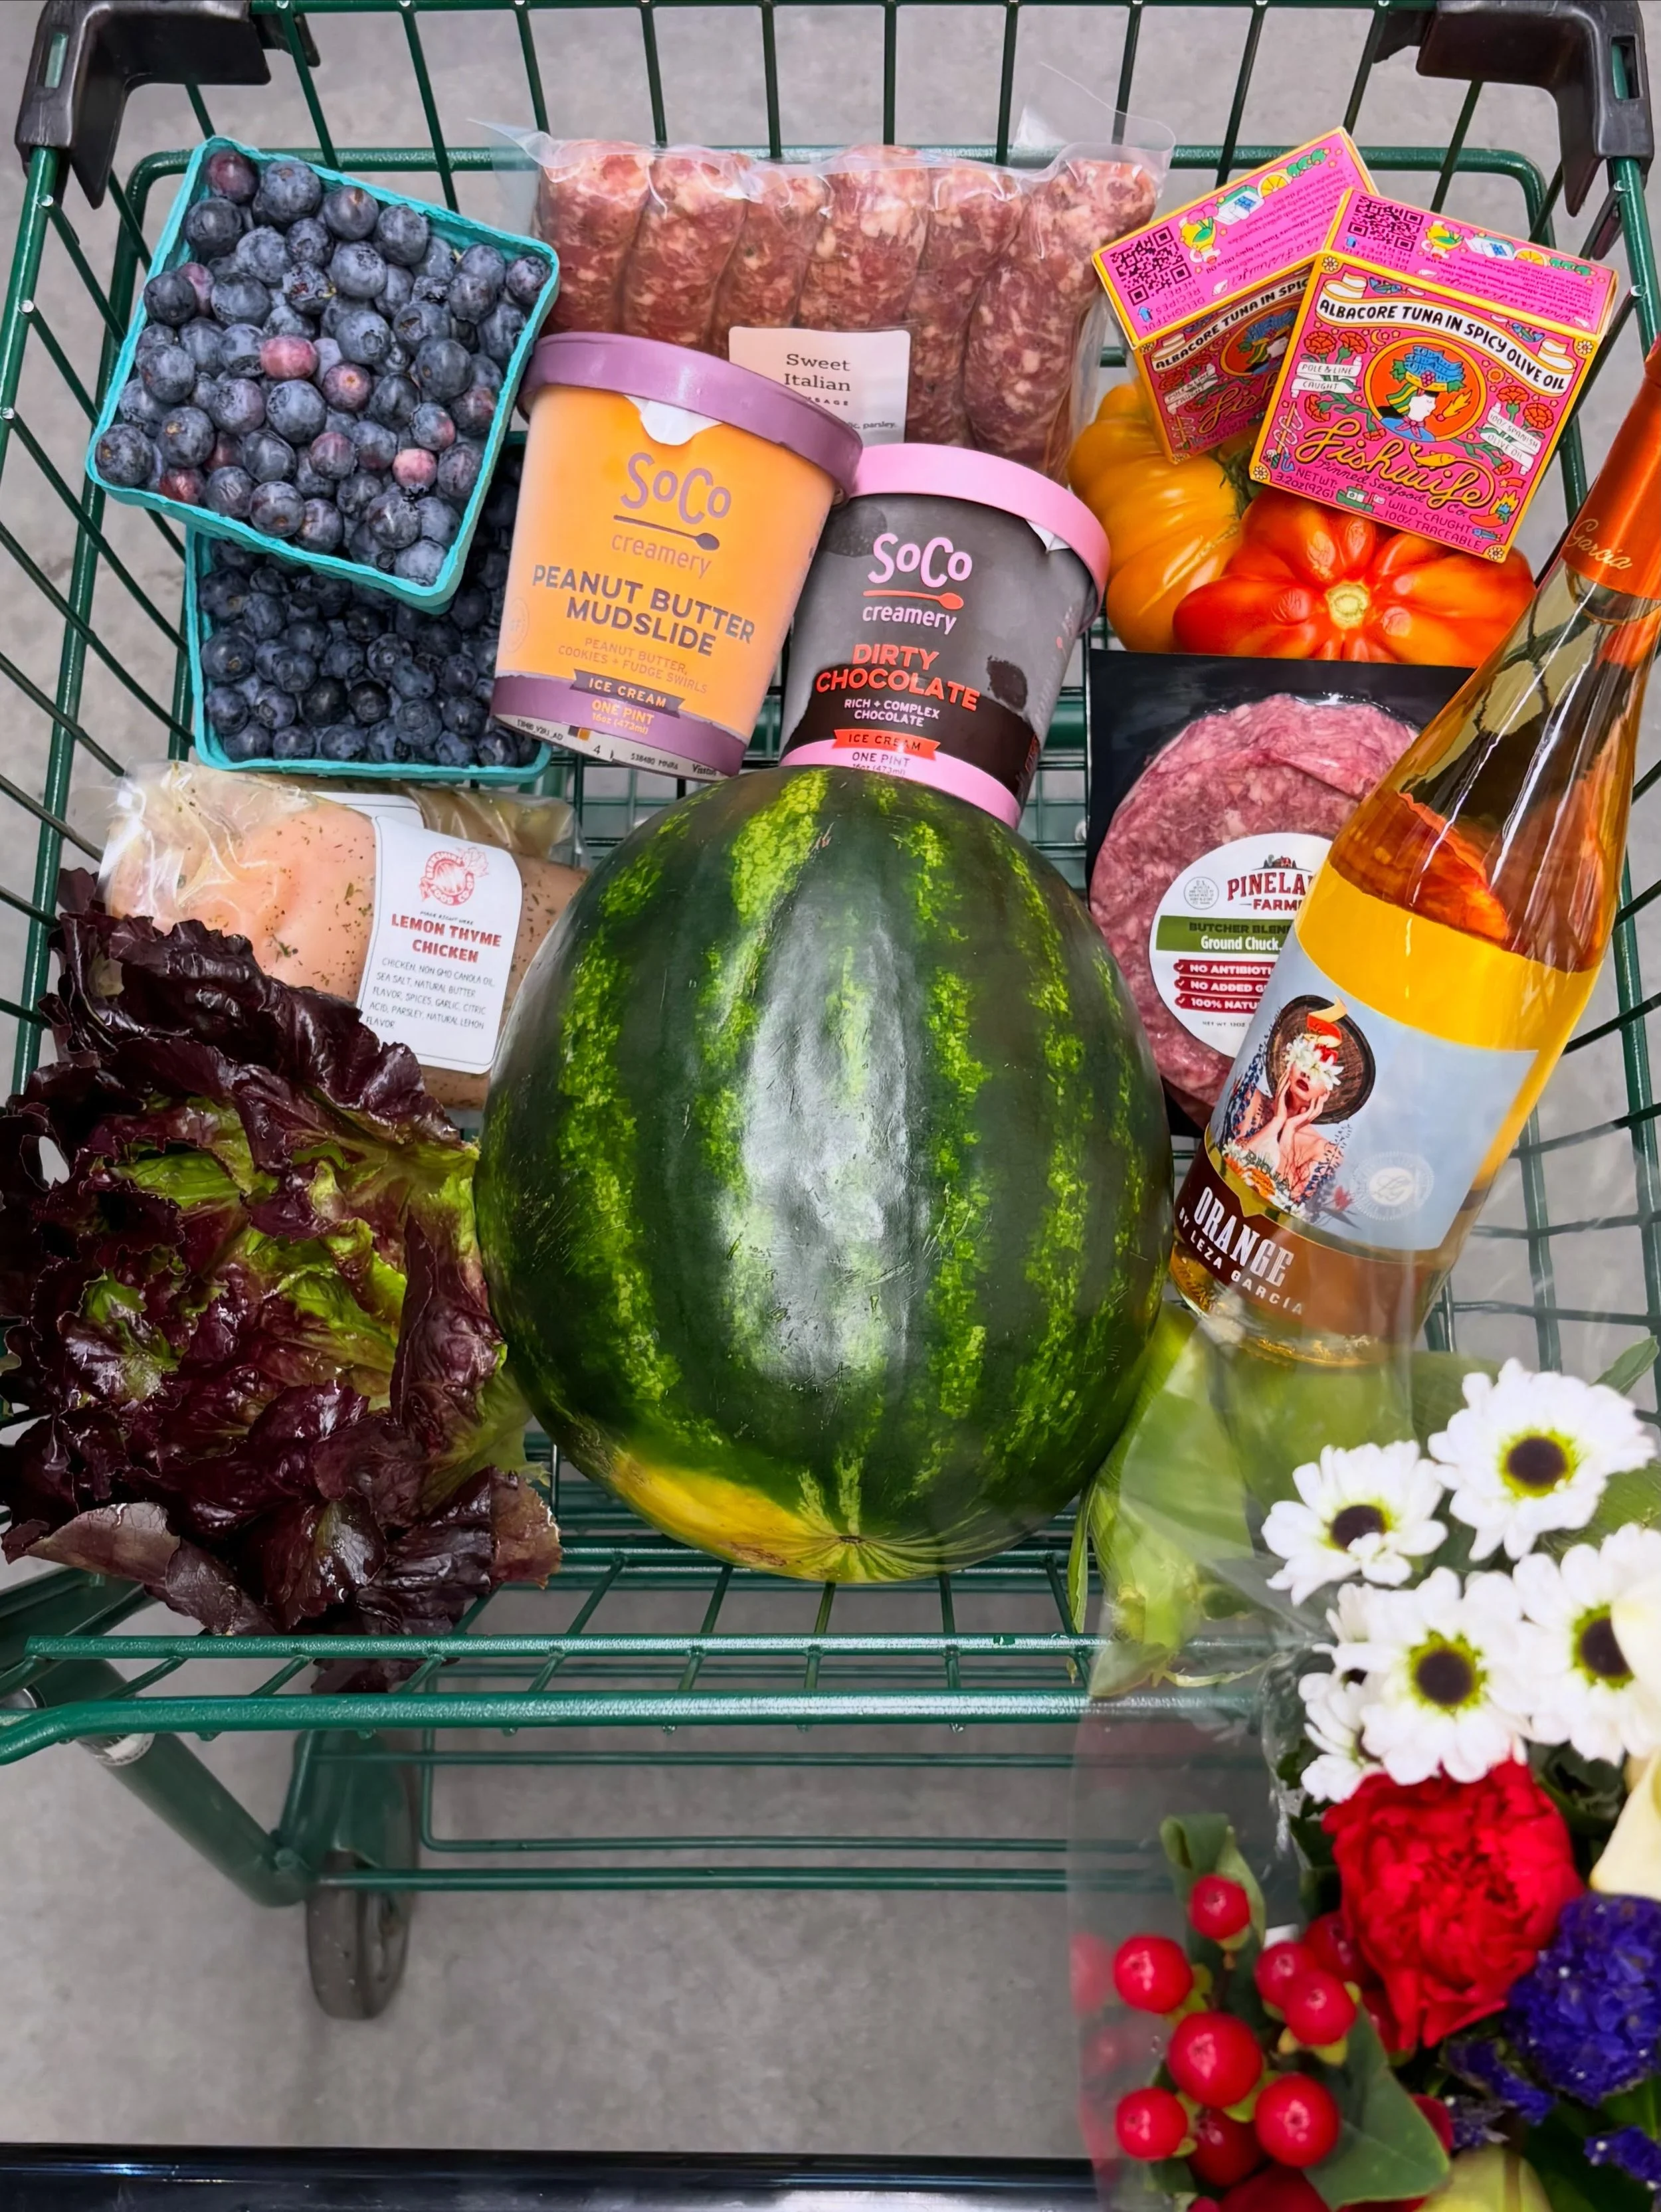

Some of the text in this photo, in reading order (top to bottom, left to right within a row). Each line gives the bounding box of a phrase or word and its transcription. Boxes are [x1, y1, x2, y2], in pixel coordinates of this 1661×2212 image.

[1142, 297, 1205, 331] DELIGHTFUL
[1156, 288, 1201, 314] RECIPES
[1156, 278, 1309, 369] ALBACORE TUNA IN SPIC
[1319, 300, 1565, 389] ALBACORE TUNA IN SPICY OLIVE OIL
[786, 353, 850, 371] Sweet
[784, 373, 851, 392] Italian
[1302, 381, 1339, 390] CAUGHT
[1488, 434, 1523, 460] OLIVE OIL
[1507, 425, 1538, 448] SPANISH
[1296, 417, 1495, 509] Fishwife
[621, 452, 732, 525] SoCo
[1315, 459, 1369, 484] Tinned
[1369, 478, 1427, 504] Seafood
[1388, 500, 1473, 531] WILD-CAUGHT
[1384, 510, 1482, 549] 100% TRACEABLE
[611, 534, 712, 580] creamery
[867, 532, 973, 588] SoCo
[532, 565, 755, 644] PEANUT BUTTER
[566, 597, 716, 656] MUDSLIDE
[862, 603, 957, 635] creamery
[585, 637, 688, 675] PEANUT BUTTER,
[852, 643, 939, 671] DIRTY
[557, 646, 608, 664] COOKIES
[623, 660, 662, 680] FUDGE
[666, 673, 708, 694] SWIRLS
[589, 678, 666, 708] ICE CREAM
[816, 668, 981, 711] CHOCOLATE
[591, 699, 654, 725] ONE PINT
[592, 713, 612, 725] 16oz
[844, 699, 870, 709] RICH
[884, 699, 940, 719] COMPLEX
[854, 709, 925, 727] CHOCOLATE
[593, 745, 601, 755] 4
[848, 734, 922, 751] ICE CREAM
[852, 751, 911, 767] ONE PINT
[431, 885, 454, 904] FOOD
[1227, 872, 1314, 901] PINELA
[391, 913, 502, 947] LEMON THYME
[1189, 922, 1249, 934] BUTCHER
[412, 939, 479, 963] CHICKEN
[1201, 935, 1242, 951] Ground
[453, 971, 482, 984] CANOLA
[1190, 965, 1273, 975] NO ANTIBIOTI
[376, 972, 476, 998] SEA SALT, NATURAL BUTTER
[1190, 980, 1209, 990] NO
[1211, 982, 1252, 992] ADDED
[369, 1001, 484, 1030] ACID, PARSLEY, NATURAL LEMON
[462, 1004, 487, 1015] CITRIC
[1191, 998, 1259, 1009] 100% NATU
[1179, 1207, 1189, 1228] BY
[1191, 1230, 1222, 1269] LEZA
[1194, 1186, 1294, 1287] ORANGE
